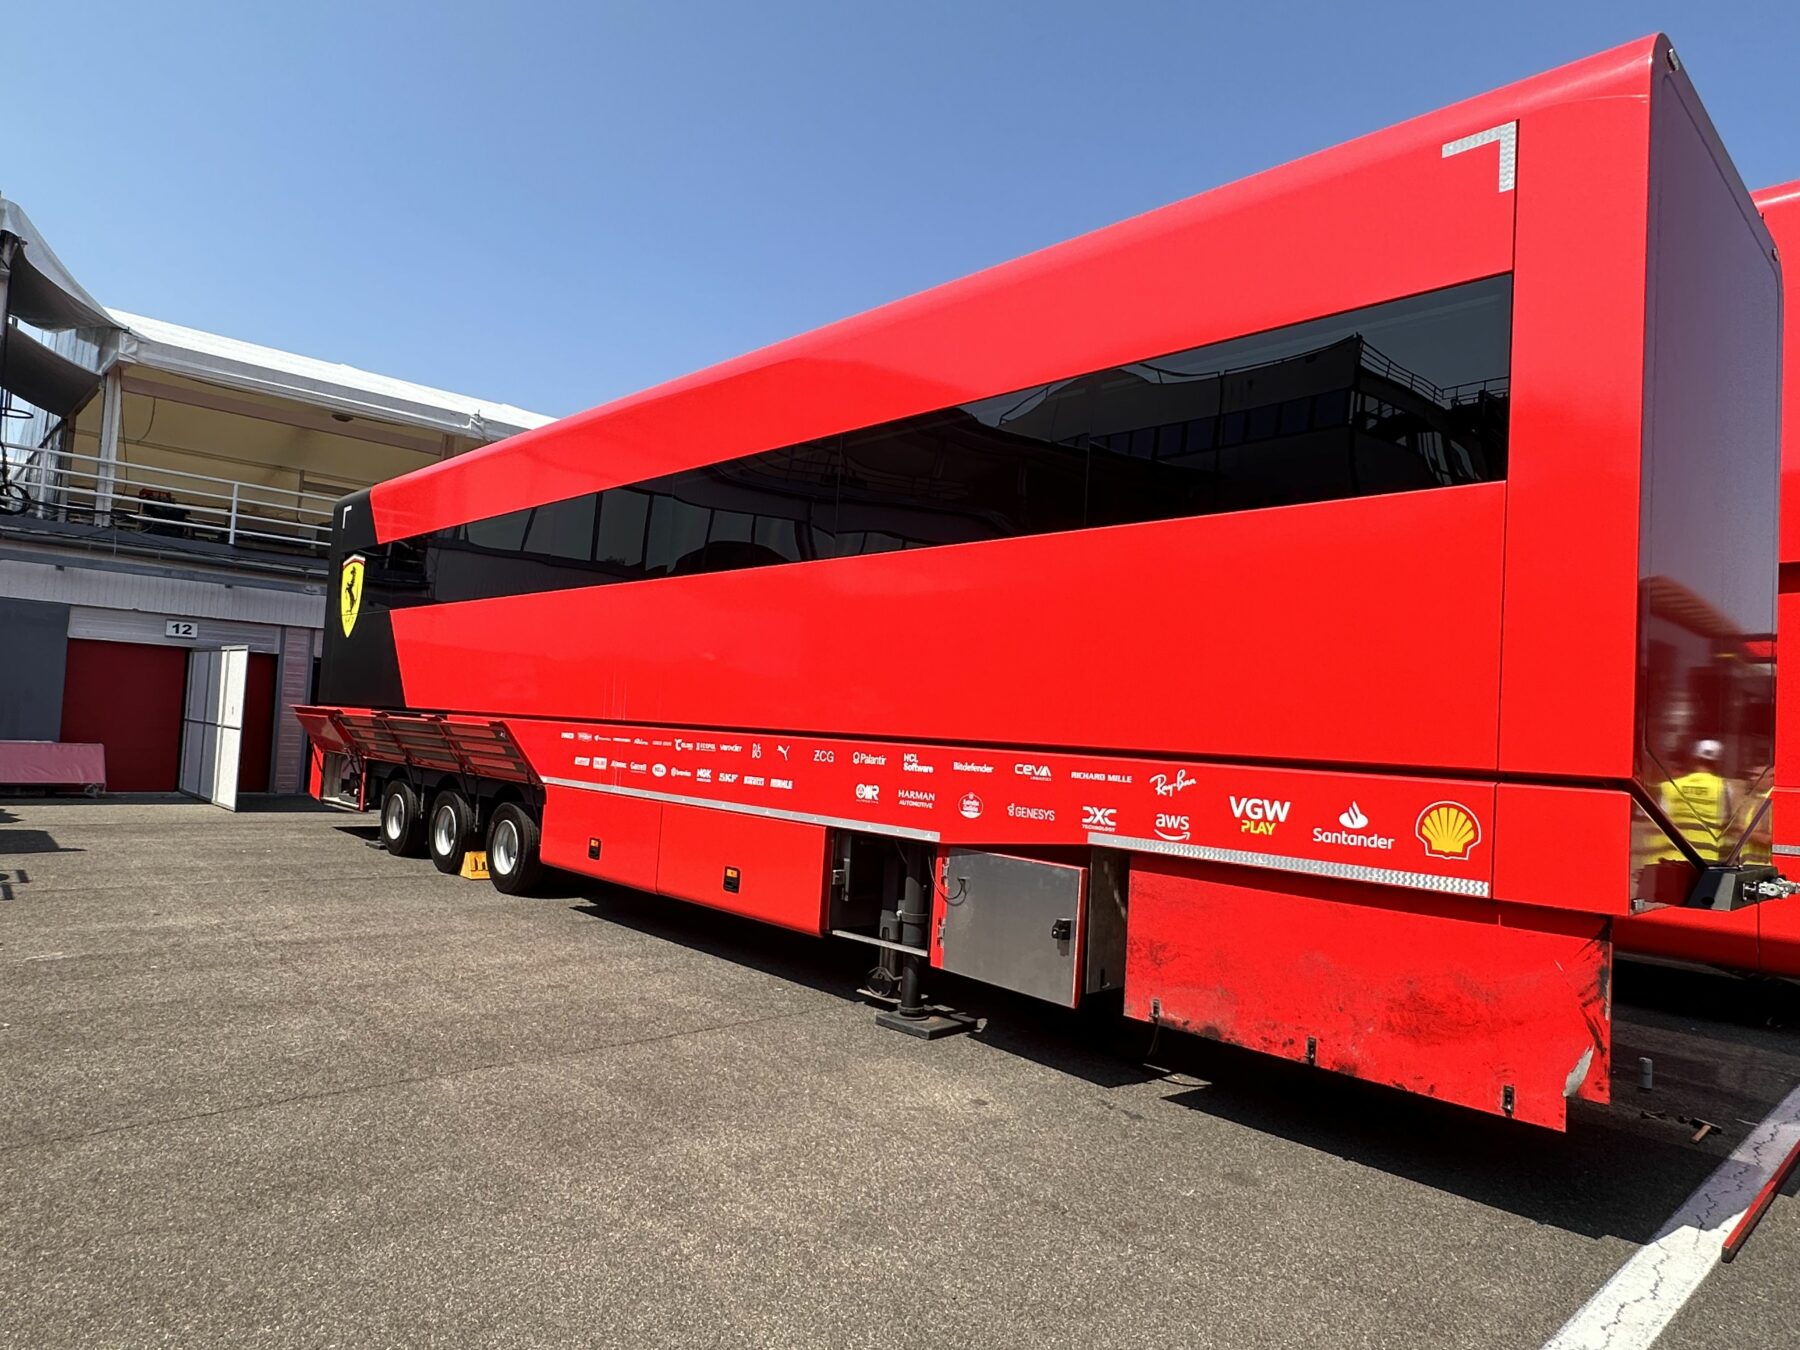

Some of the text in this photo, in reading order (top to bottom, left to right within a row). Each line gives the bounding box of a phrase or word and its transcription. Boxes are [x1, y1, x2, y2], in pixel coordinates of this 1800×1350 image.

[172, 623, 192, 635] 12
[814, 750, 834, 762] ZCG
[859, 753, 886, 765] Palantir
[903, 752, 919, 763] HCL
[903, 762, 934, 773] Software
[953, 762, 994, 773] Bitdefender
[719, 773, 738, 782] SKF
[1071, 772, 1132, 783] RICHARD MILLE
[1150, 769, 1196, 797] Ray-Ban
[898, 789, 935, 801] HARMAN
[898, 799, 933, 809] AUTOMOTIVE
[1228, 795, 1291, 822] VGW
[1015, 807, 1055, 821] GENESYS
[1155, 813, 1190, 831] aws
[1240, 819, 1276, 836] PLAY
[1313, 828, 1395, 850] Santander
